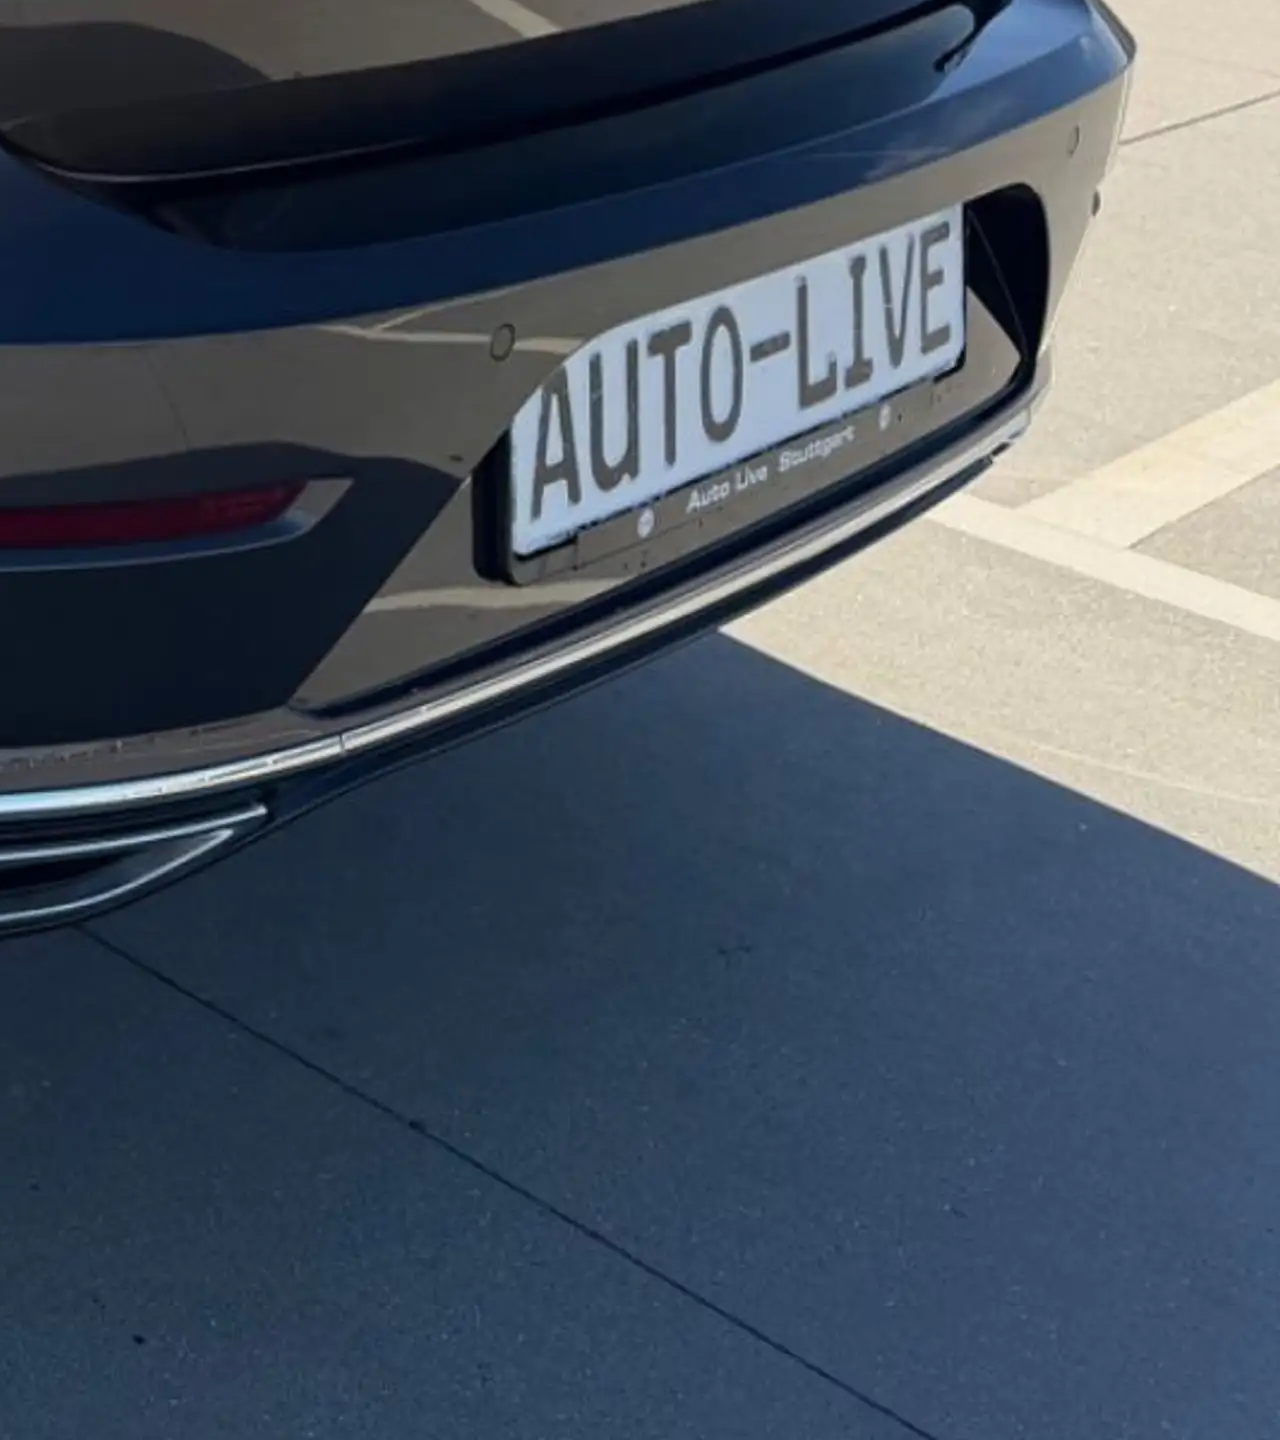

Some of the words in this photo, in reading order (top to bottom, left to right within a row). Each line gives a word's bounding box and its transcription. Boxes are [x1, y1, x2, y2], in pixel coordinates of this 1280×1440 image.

[530, 220, 952, 522] AUTO-LIVE
[686, 478, 731, 514] Auto
[735, 463, 769, 492] Live
[777, 424, 857, 473] Stuttgart
